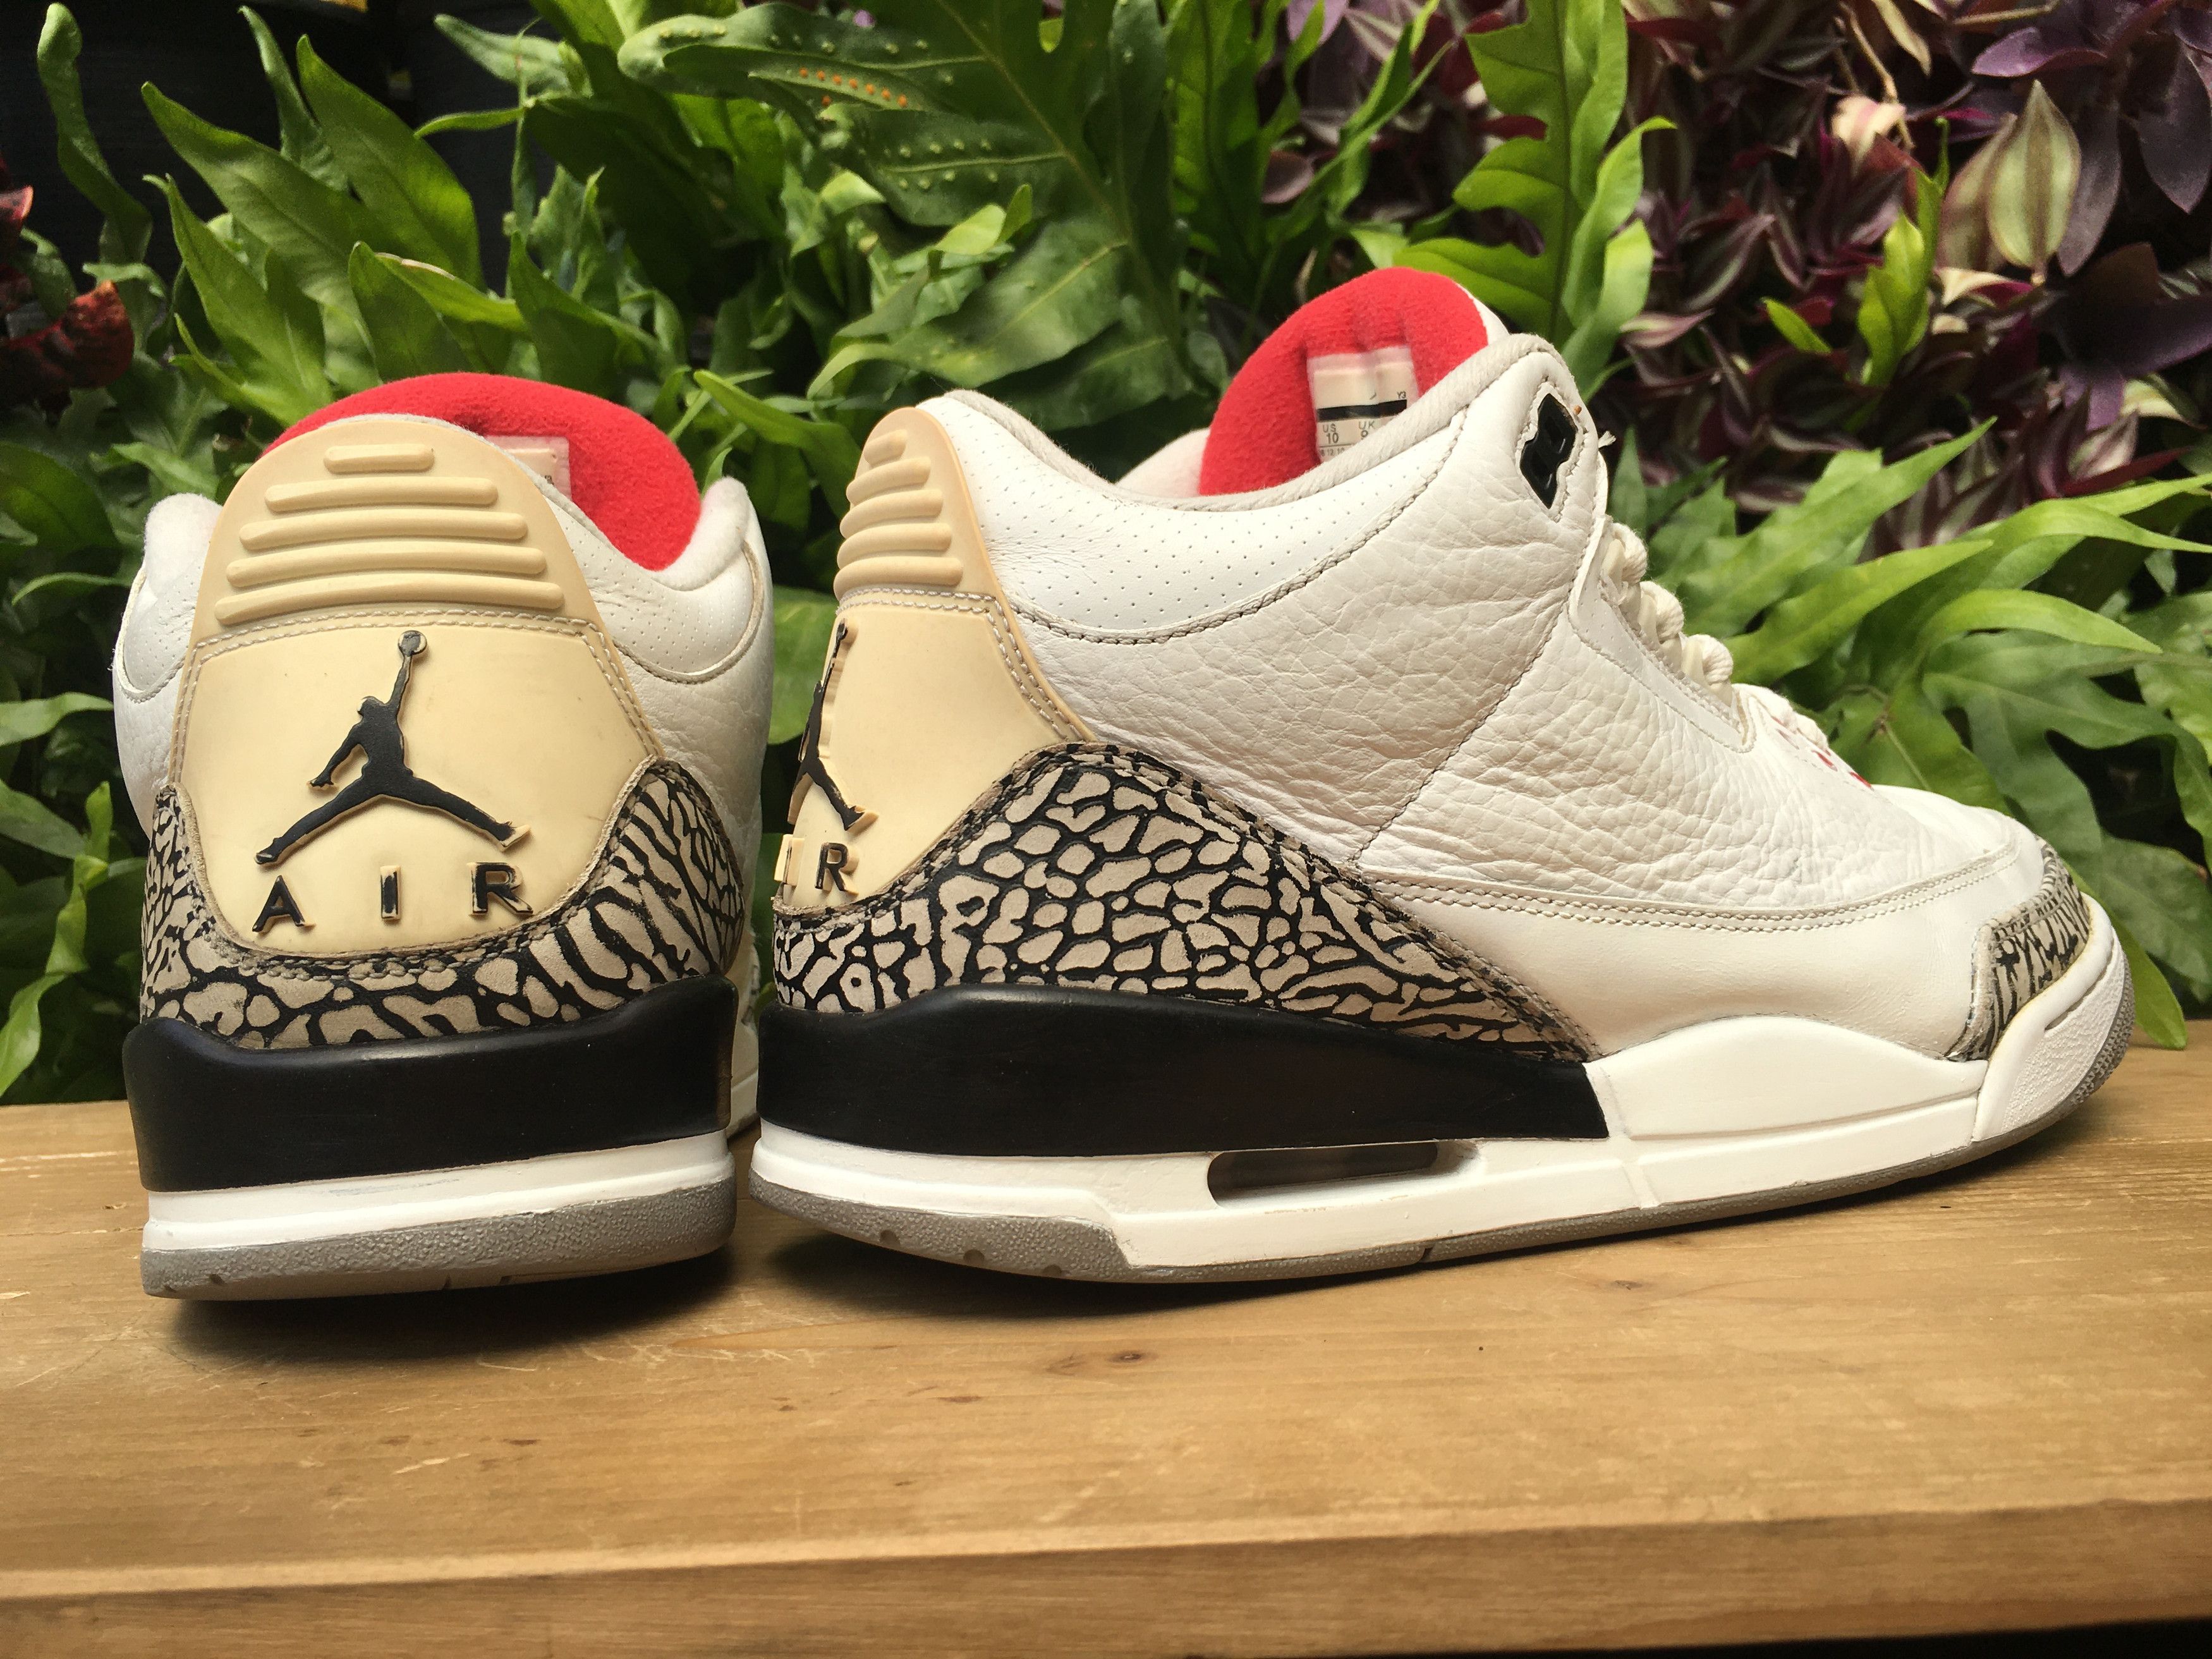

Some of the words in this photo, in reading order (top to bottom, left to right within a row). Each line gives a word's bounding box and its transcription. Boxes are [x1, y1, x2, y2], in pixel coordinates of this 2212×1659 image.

[1322, 423, 1337, 433] US
[1358, 420, 1375, 430] UK
[1326, 432, 1339, 444] 10
[252, 861, 534, 933] AIR
